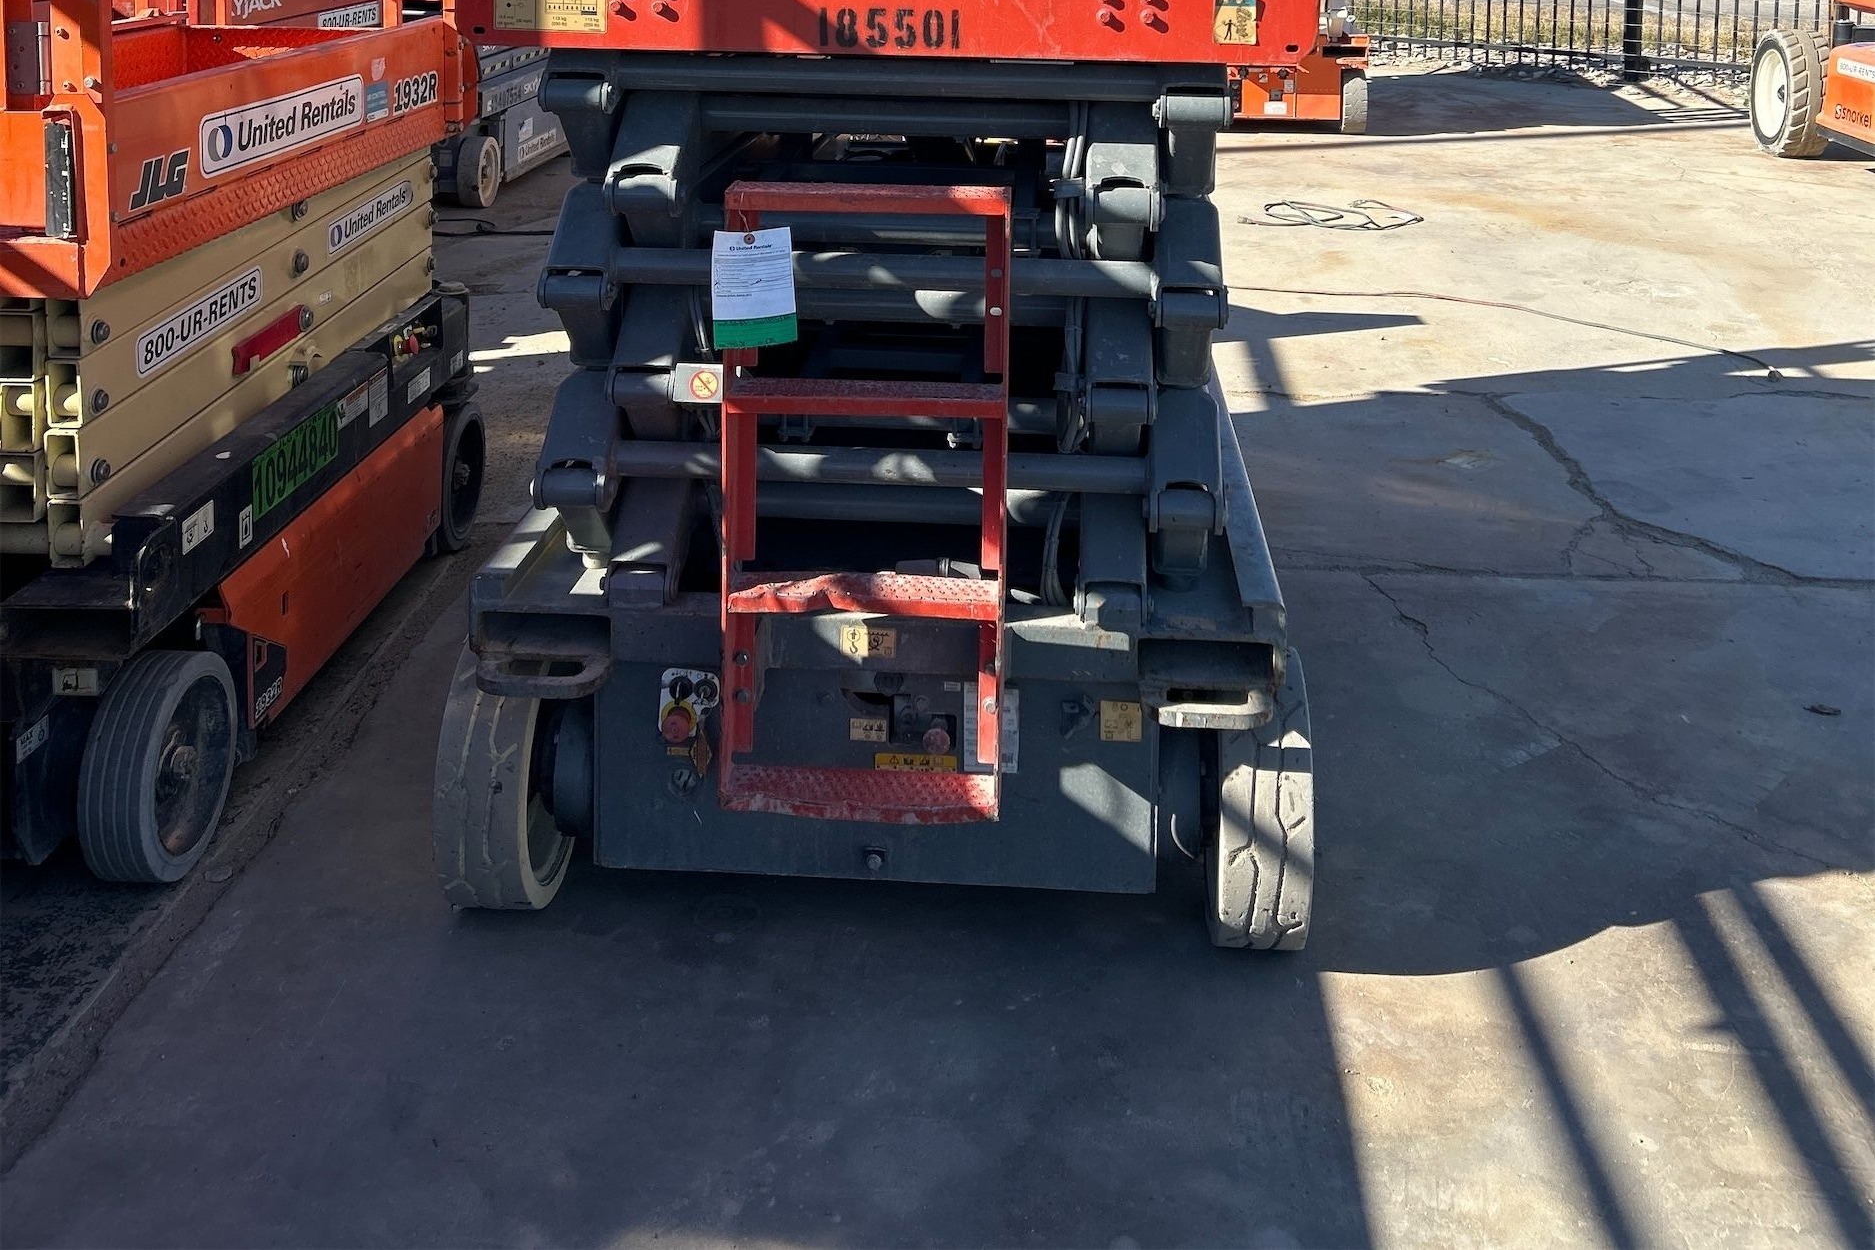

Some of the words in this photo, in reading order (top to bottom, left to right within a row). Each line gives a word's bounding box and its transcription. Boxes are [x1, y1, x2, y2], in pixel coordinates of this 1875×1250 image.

[819, 7, 960, 50] 185501
[237, 105, 297, 151] United
[300, 86, 357, 131] Rentals
[394, 72, 438, 114] 1932R
[1841, 107, 1872, 128] snorkel
[130, 149, 189, 211] JLG
[344, 204, 375, 238] United
[376, 187, 406, 220] Rentals
[144, 276, 257, 365] 800-UR-RENTS
[254, 410, 338, 516] 10944840
